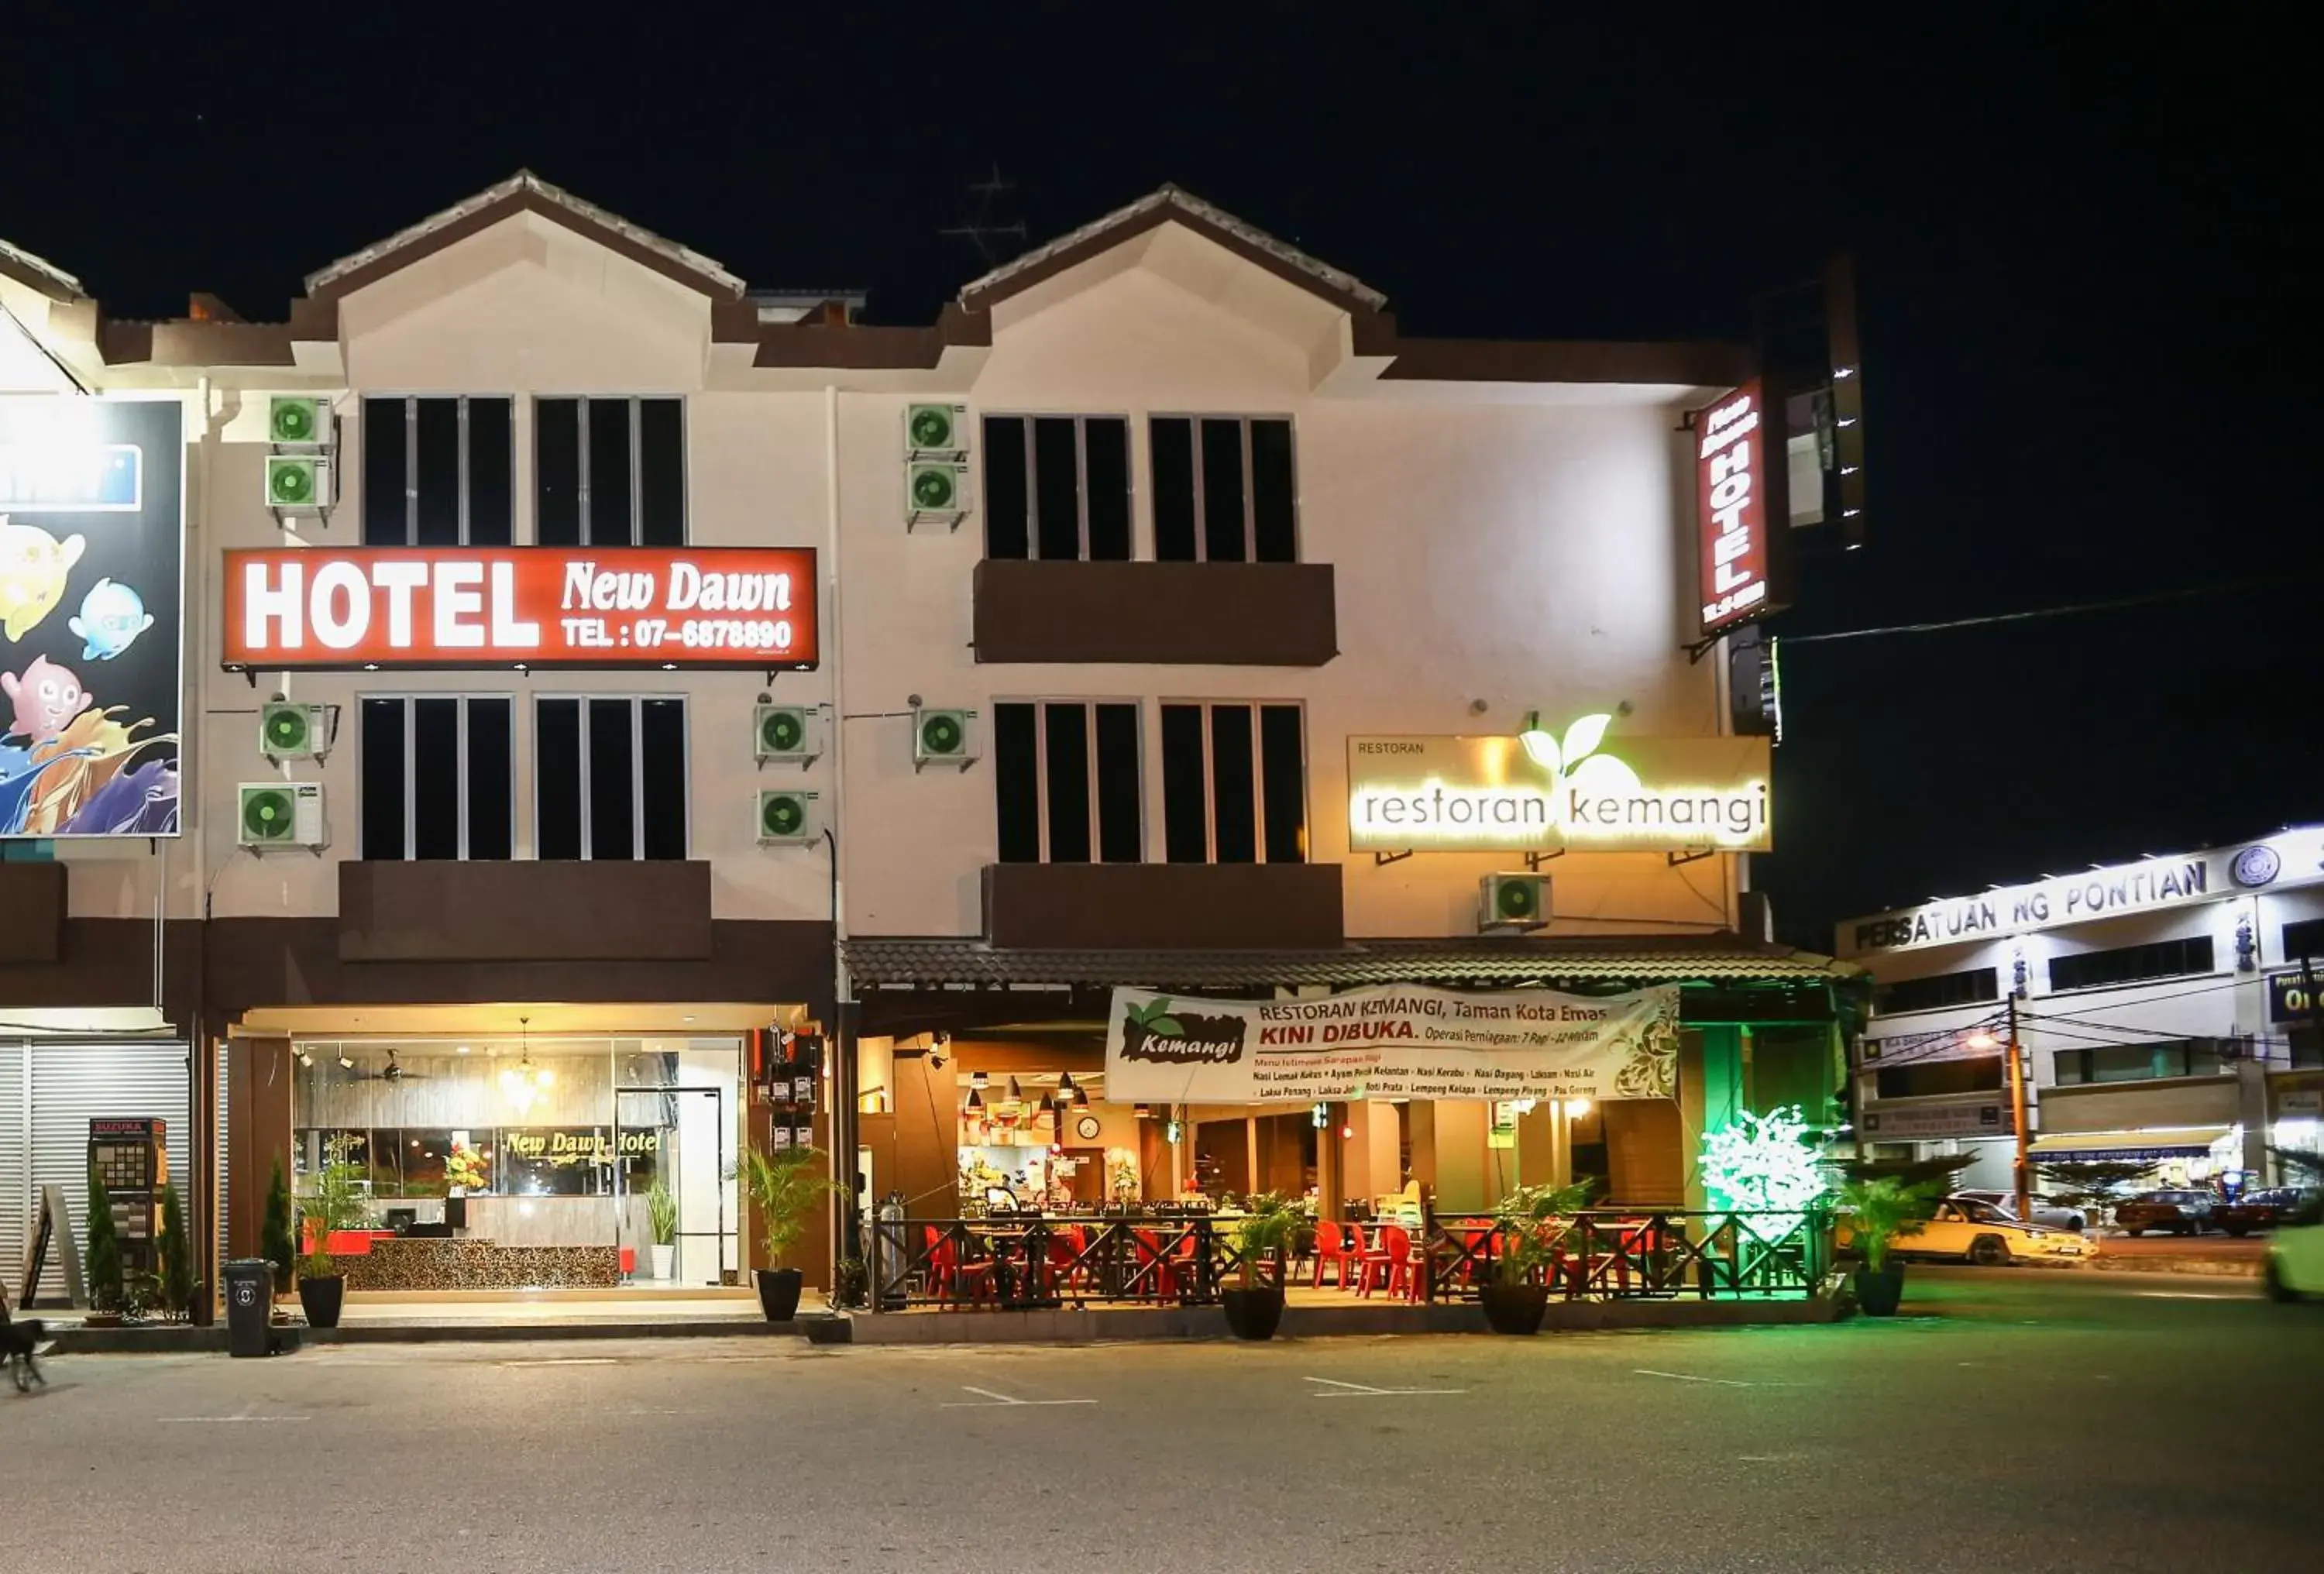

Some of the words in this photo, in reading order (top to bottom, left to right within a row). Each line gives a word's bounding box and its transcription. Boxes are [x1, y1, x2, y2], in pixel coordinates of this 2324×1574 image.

[1709, 439, 1752, 595] HOTEL
[244, 561, 541, 649] HOTEL
[561, 562, 655, 611] New
[669, 562, 792, 611] Dawn
[1358, 742, 1425, 754] RESTORAN
[1366, 788, 1546, 824] restoran
[1569, 785, 1768, 833] kemangi
[1855, 902, 1997, 950] PERSATUAN
[2066, 861, 2207, 915] PONTIAN
[1260, 1001, 1356, 1021] RESTORAN
[1452, 1001, 1511, 1019] Taman
[1516, 1004, 1555, 1022] Kota
[1560, 1006, 1608, 1022] Emas
[1141, 1033, 1239, 1059] Kemangi
[1260, 1025, 1315, 1045] KINI
[1322, 1021, 1420, 1043] DIBUKA.
[1425, 1026, 1463, 1041] Operasi
[507, 1132, 546, 1153] New
[552, 1132, 605, 1152] Dawn
